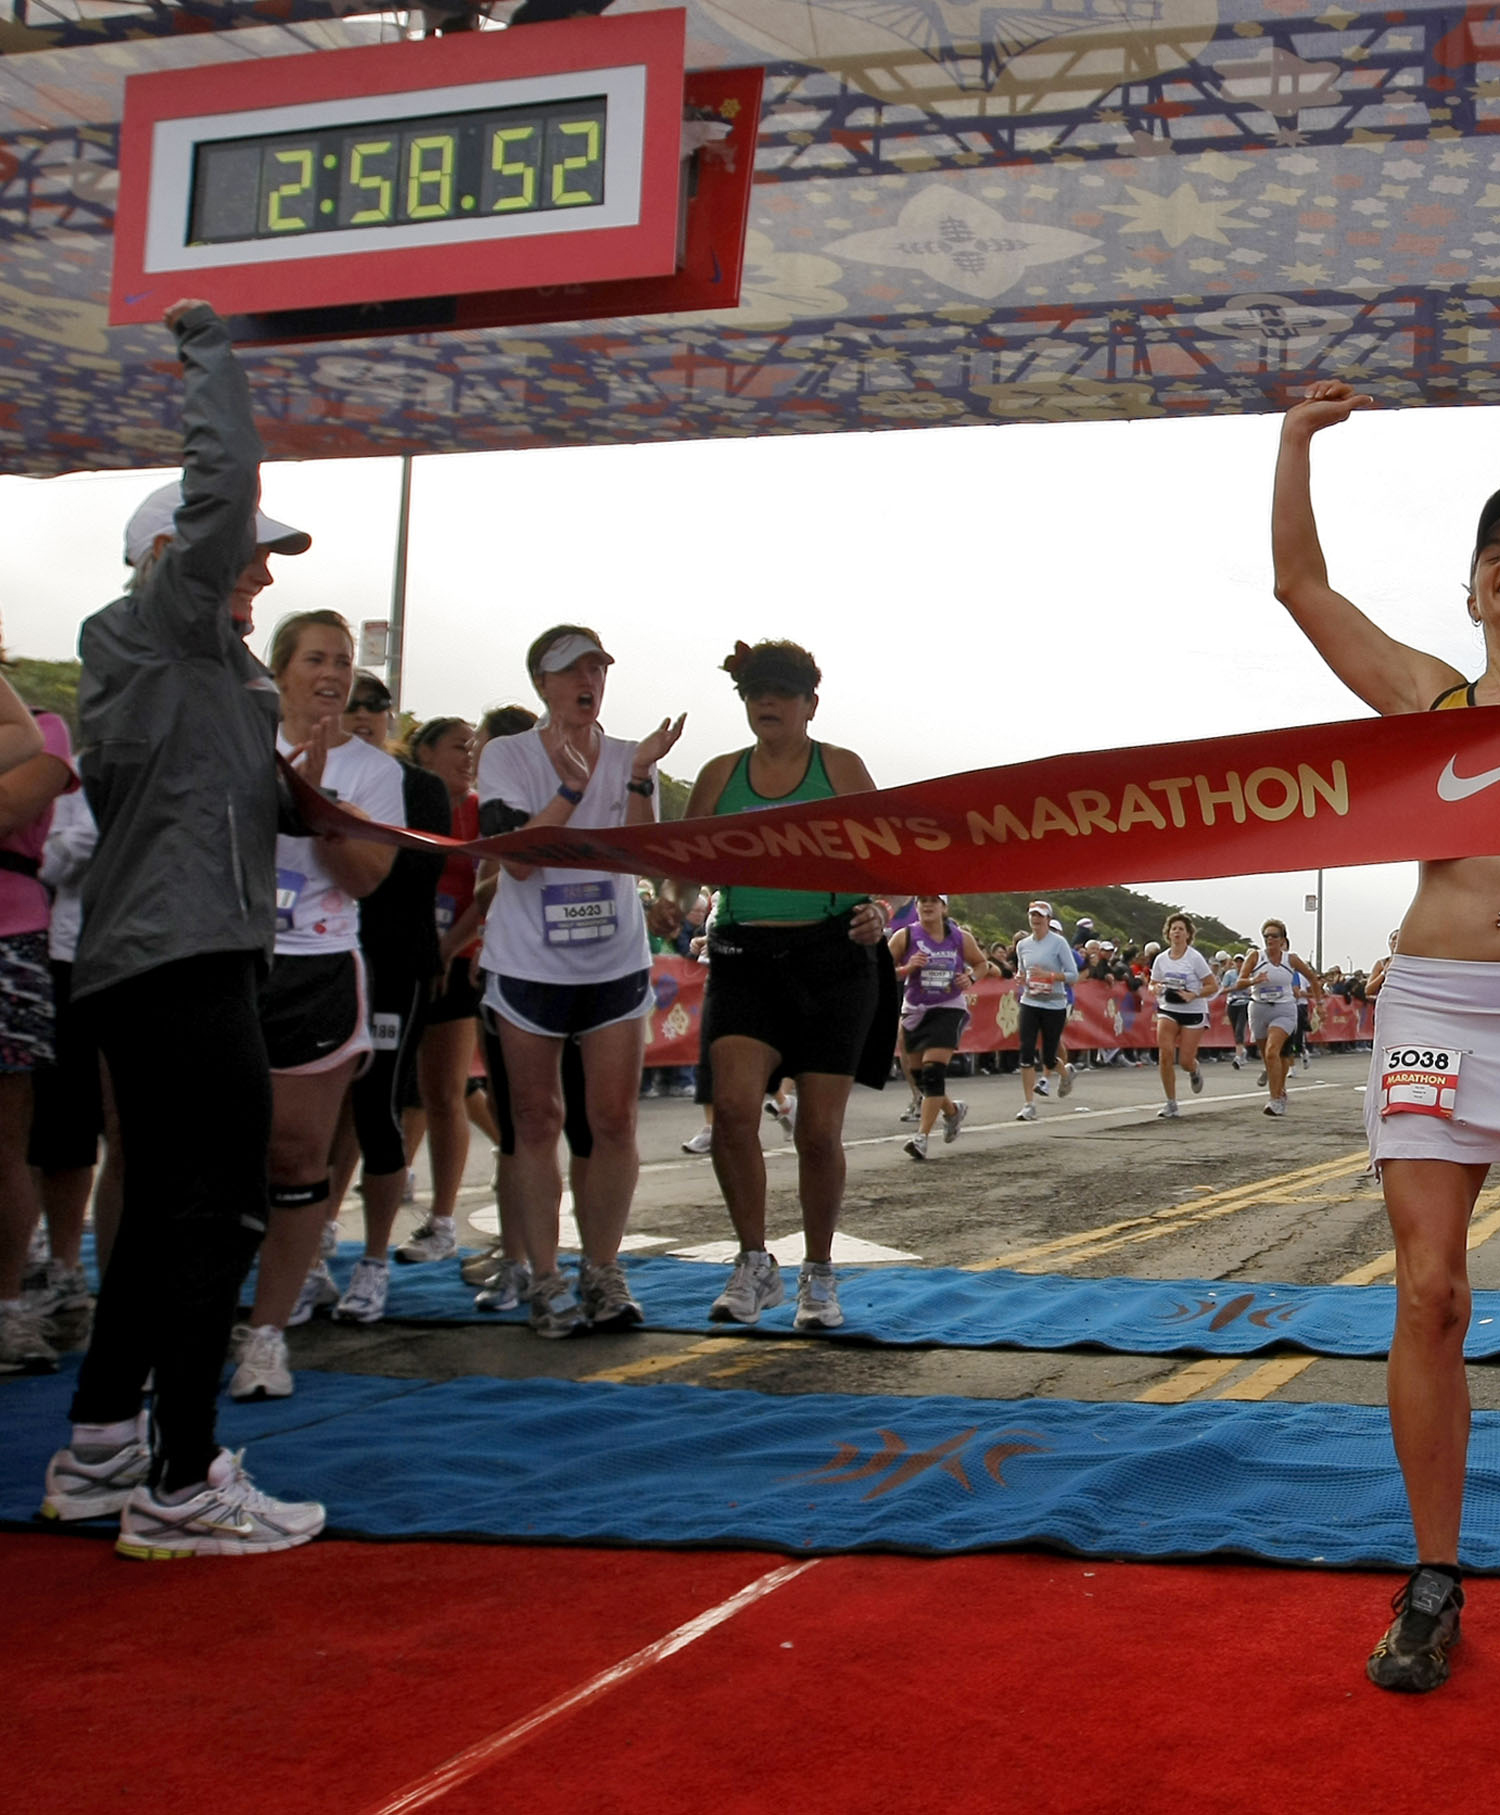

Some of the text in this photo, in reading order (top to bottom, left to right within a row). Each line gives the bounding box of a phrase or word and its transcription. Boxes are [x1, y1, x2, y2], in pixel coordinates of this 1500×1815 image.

[268, 120, 600, 231] 2:58.52
[643, 760, 1350, 863] WOMEN'S MARATHON
[563, 903, 602, 919] 16623
[1388, 1049, 1450, 1070] 5038
[1387, 1074, 1446, 1085] MARATHON
